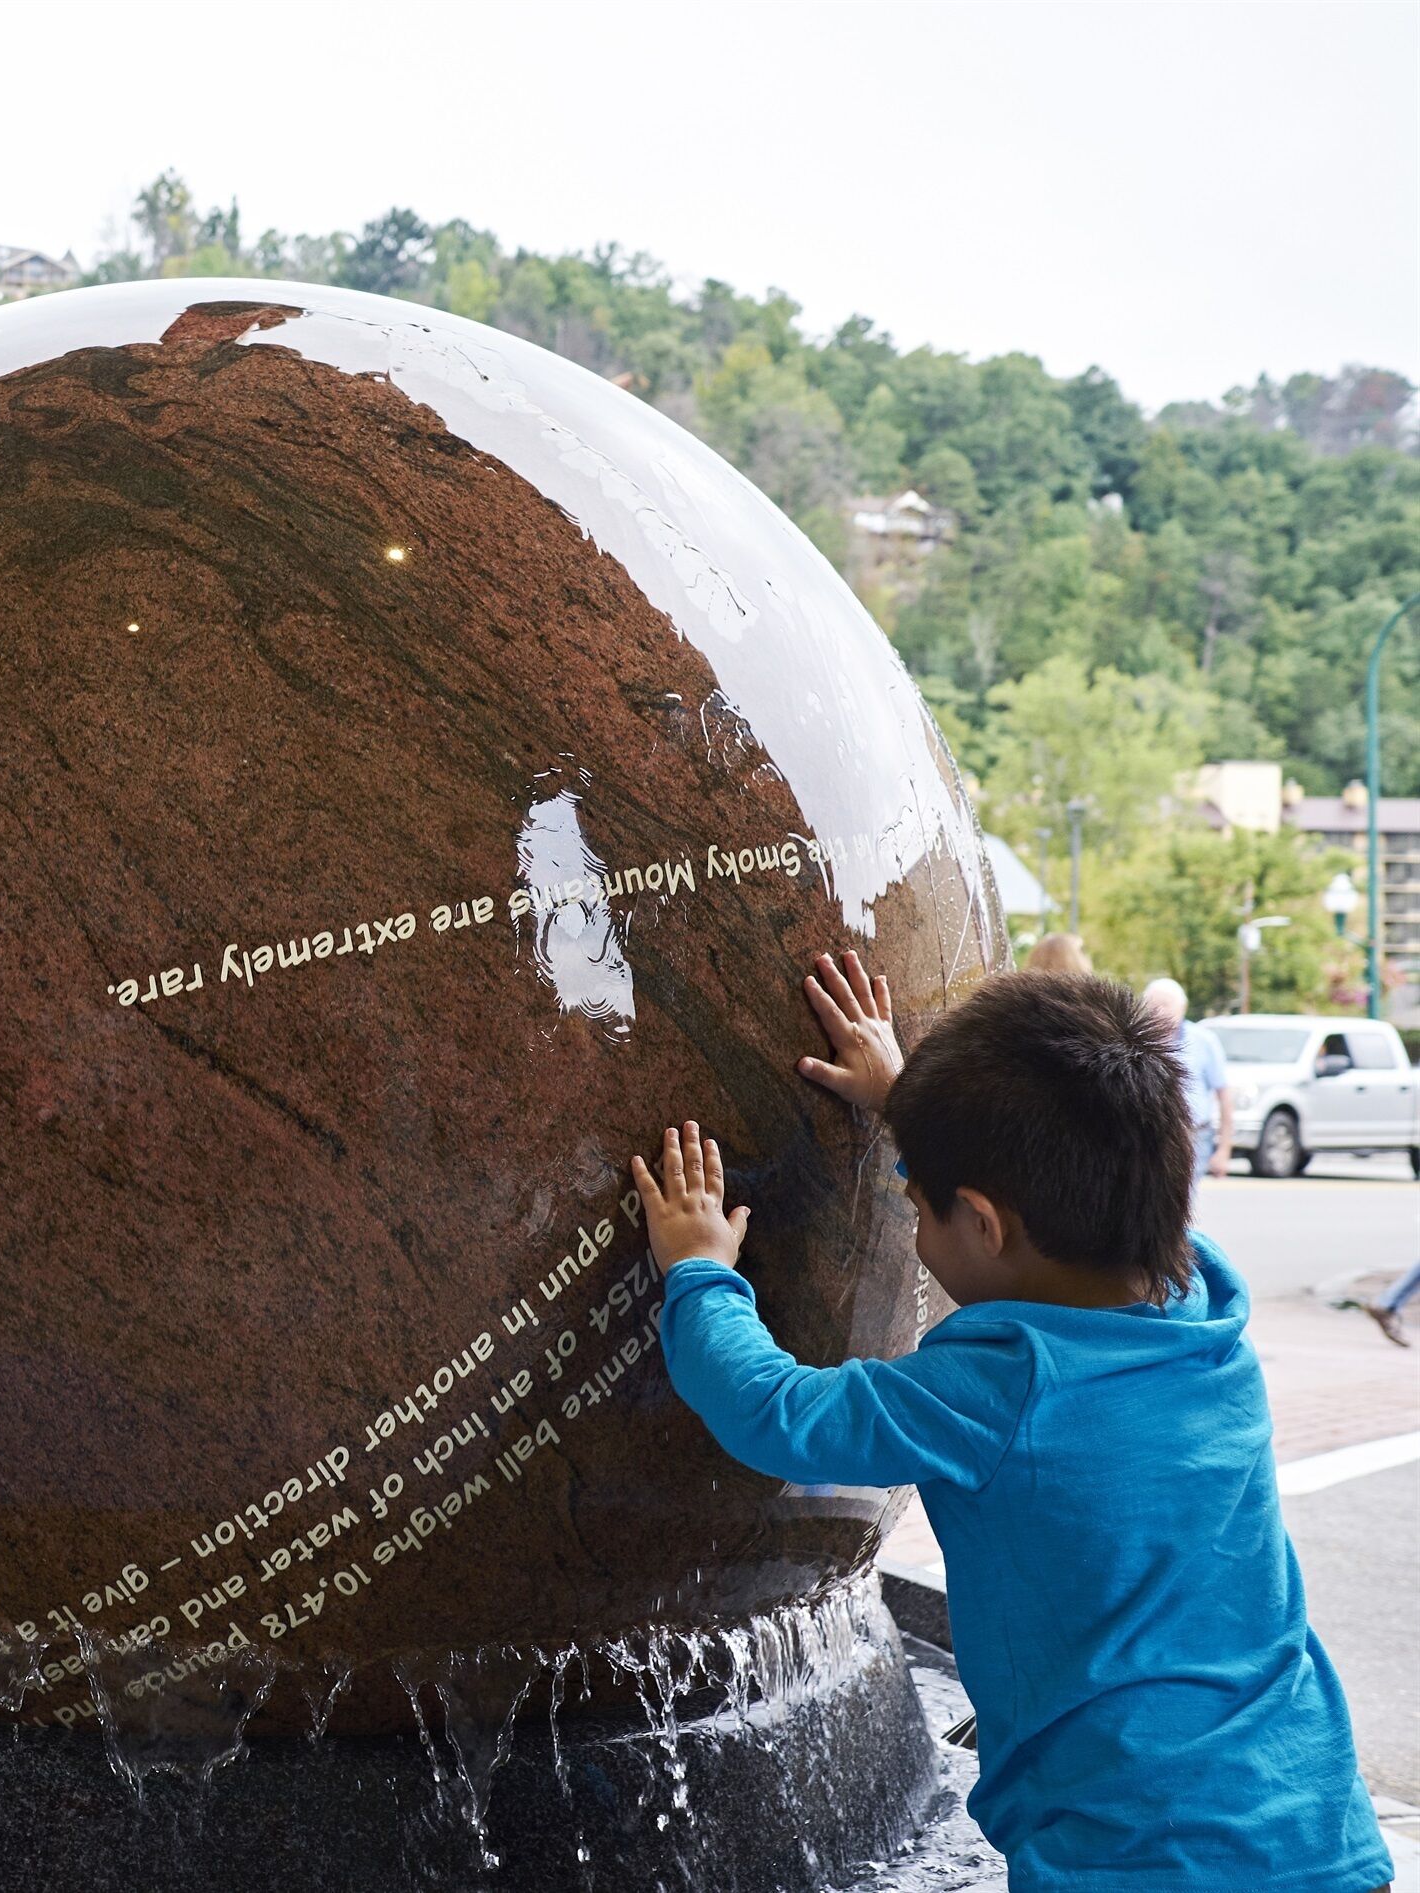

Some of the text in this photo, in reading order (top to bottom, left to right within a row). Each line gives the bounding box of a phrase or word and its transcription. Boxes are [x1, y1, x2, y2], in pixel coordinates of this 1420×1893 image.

[707, 842, 802, 884] Smoky
[430, 895, 494, 932] are
[220, 912, 417, 987] extremely
[107, 963, 204, 1006] rare.
[538, 1218, 615, 1301] spun
[501, 1298, 540, 1335] in
[545, 1330, 577, 1381] of
[365, 1332, 495, 1452] another
[490, 1369, 533, 1414] an
[413, 1412, 490, 1475] inch
[495, 1418, 560, 1482] ball
[190, 1446, 350, 1557] direction
[370, 1473, 404, 1519] of
[373, 1474, 491, 1565] weighs
[260, 1506, 360, 1582] water
[82, 1563, 150, 1613] give
[179, 1574, 247, 1628] and
[260, 1563, 371, 1638] 10,478
[15, 1620, 37, 1642] a
[47, 1605, 80, 1632] it
